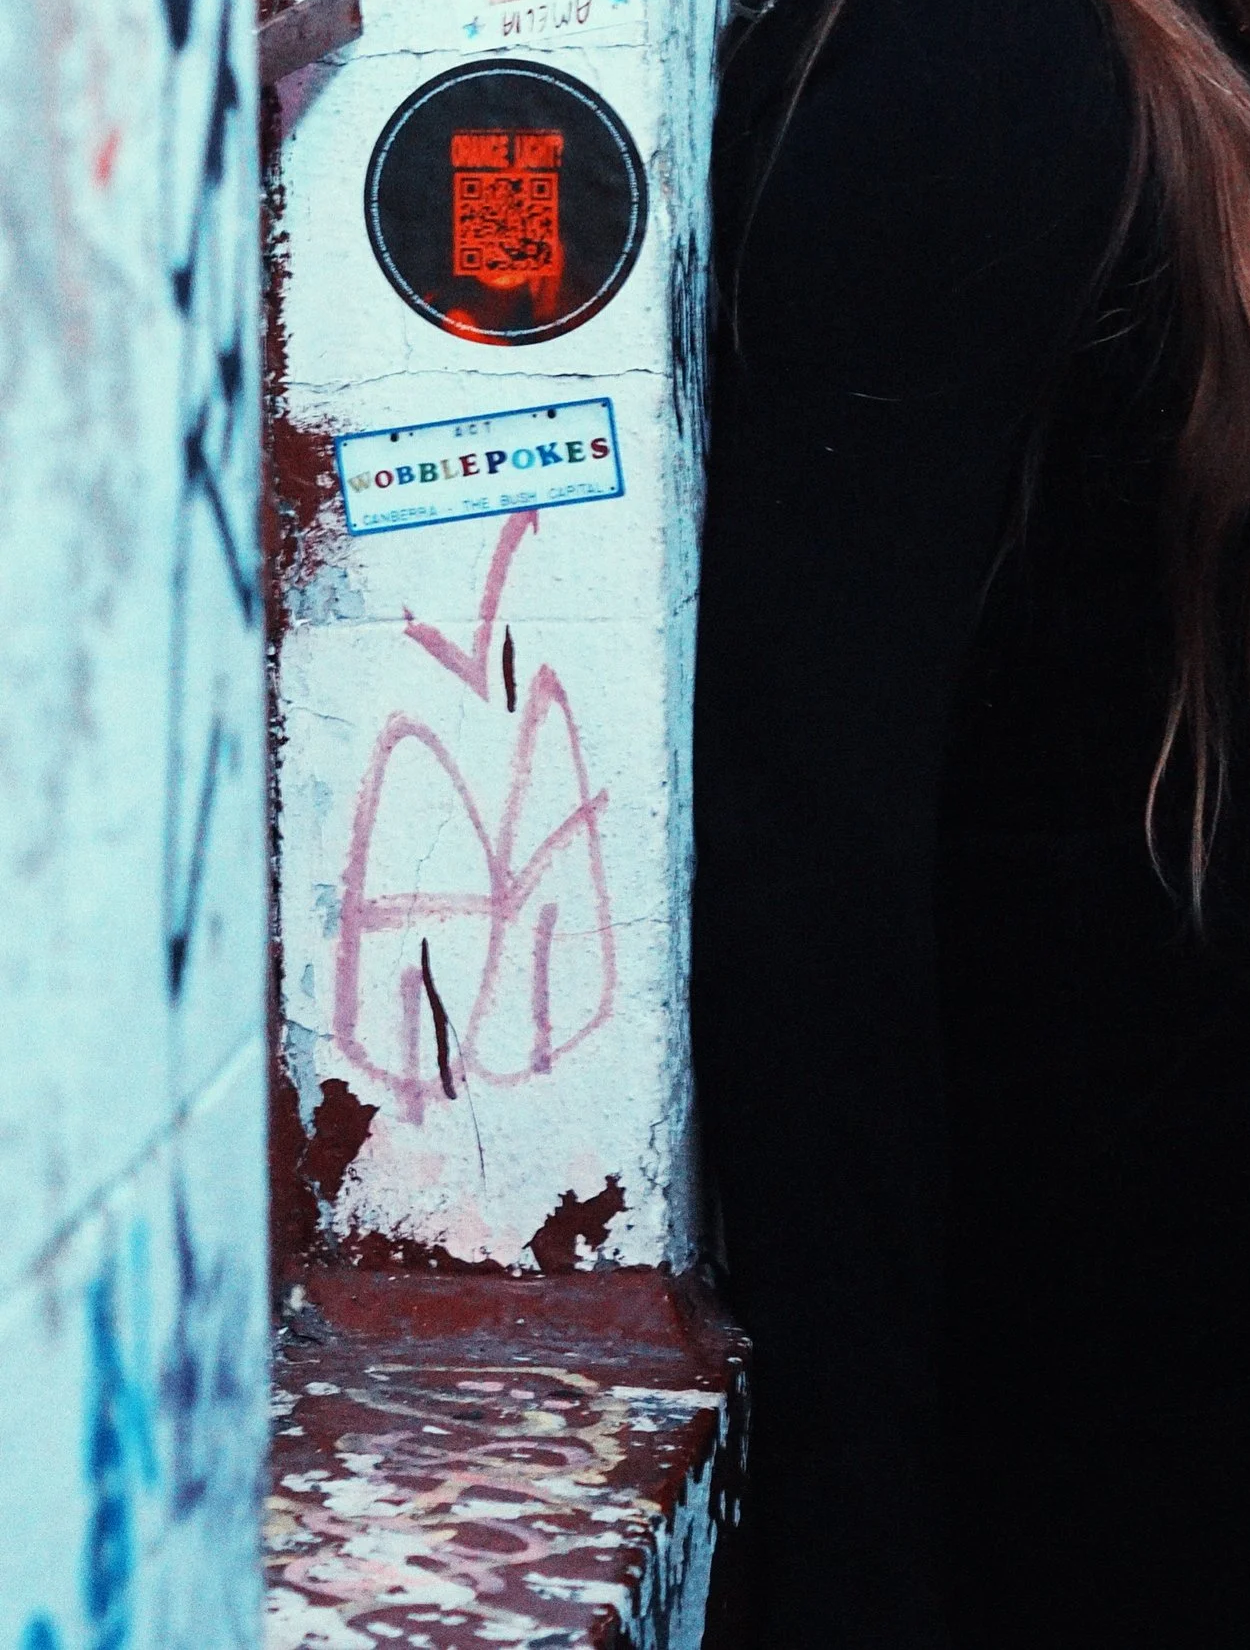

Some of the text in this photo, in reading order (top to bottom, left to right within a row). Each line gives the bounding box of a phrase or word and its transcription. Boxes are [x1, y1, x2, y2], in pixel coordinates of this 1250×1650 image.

[347, 436, 611, 494] WOBBLEPOKES
[363, 505, 438, 527] CANBERRA
[463, 497, 490, 512] THE
[499, 491, 537, 507] BUSH
[548, 482, 604, 500] CAPITAL
